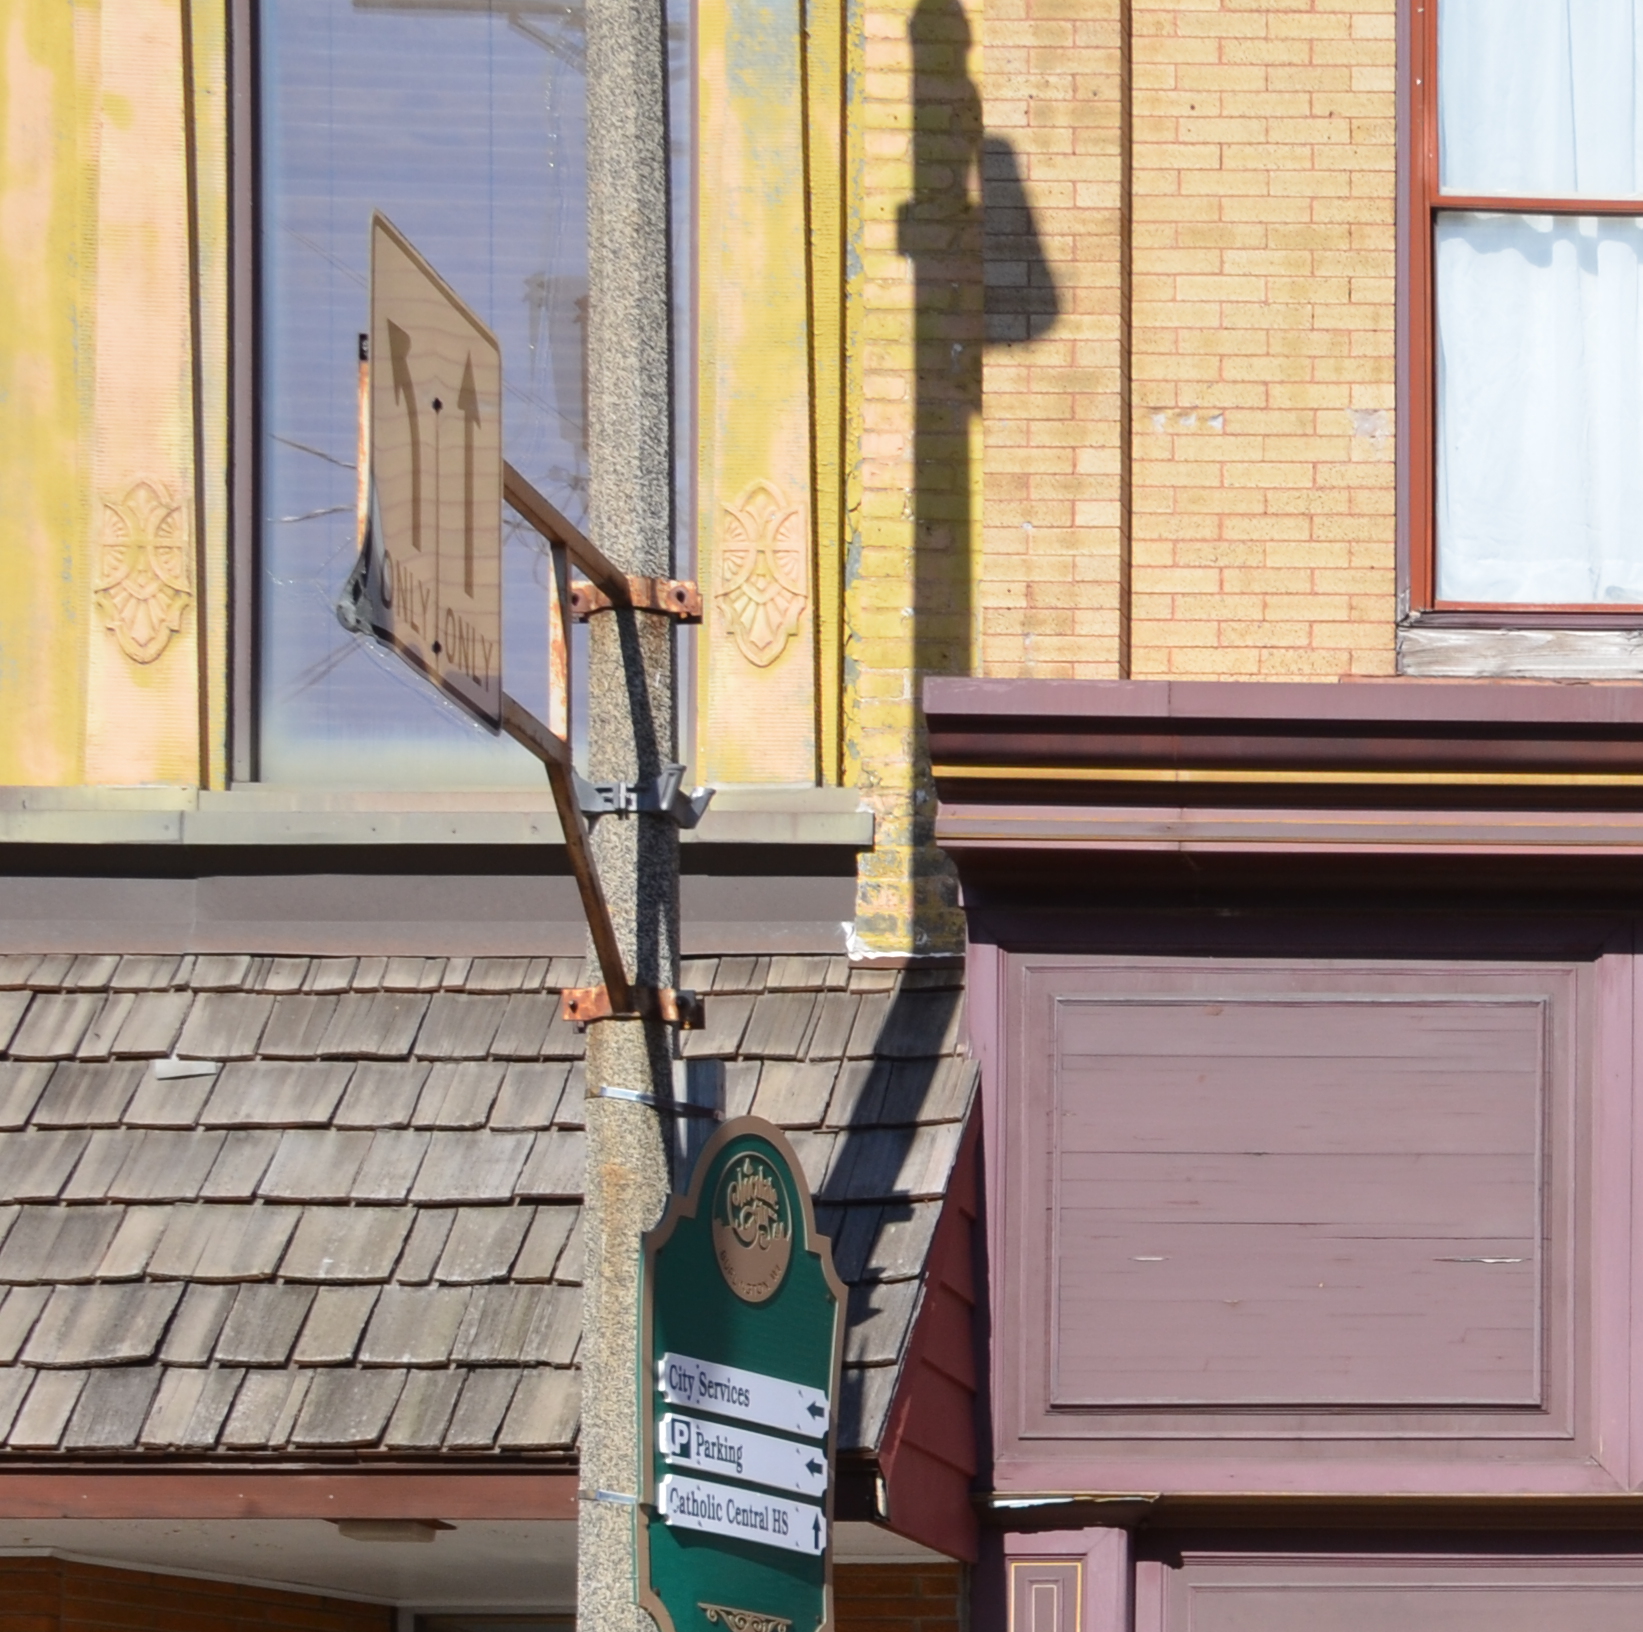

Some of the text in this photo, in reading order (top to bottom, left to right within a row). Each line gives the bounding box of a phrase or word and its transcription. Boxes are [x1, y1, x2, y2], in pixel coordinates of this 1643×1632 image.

[380, 548, 431, 641] ONLY
[444, 606, 494, 693] ONLY
[669, 1364, 750, 1408] City Services
[696, 1431, 743, 1474] Parking
[670, 1487, 790, 1536] Catholic Central HS
